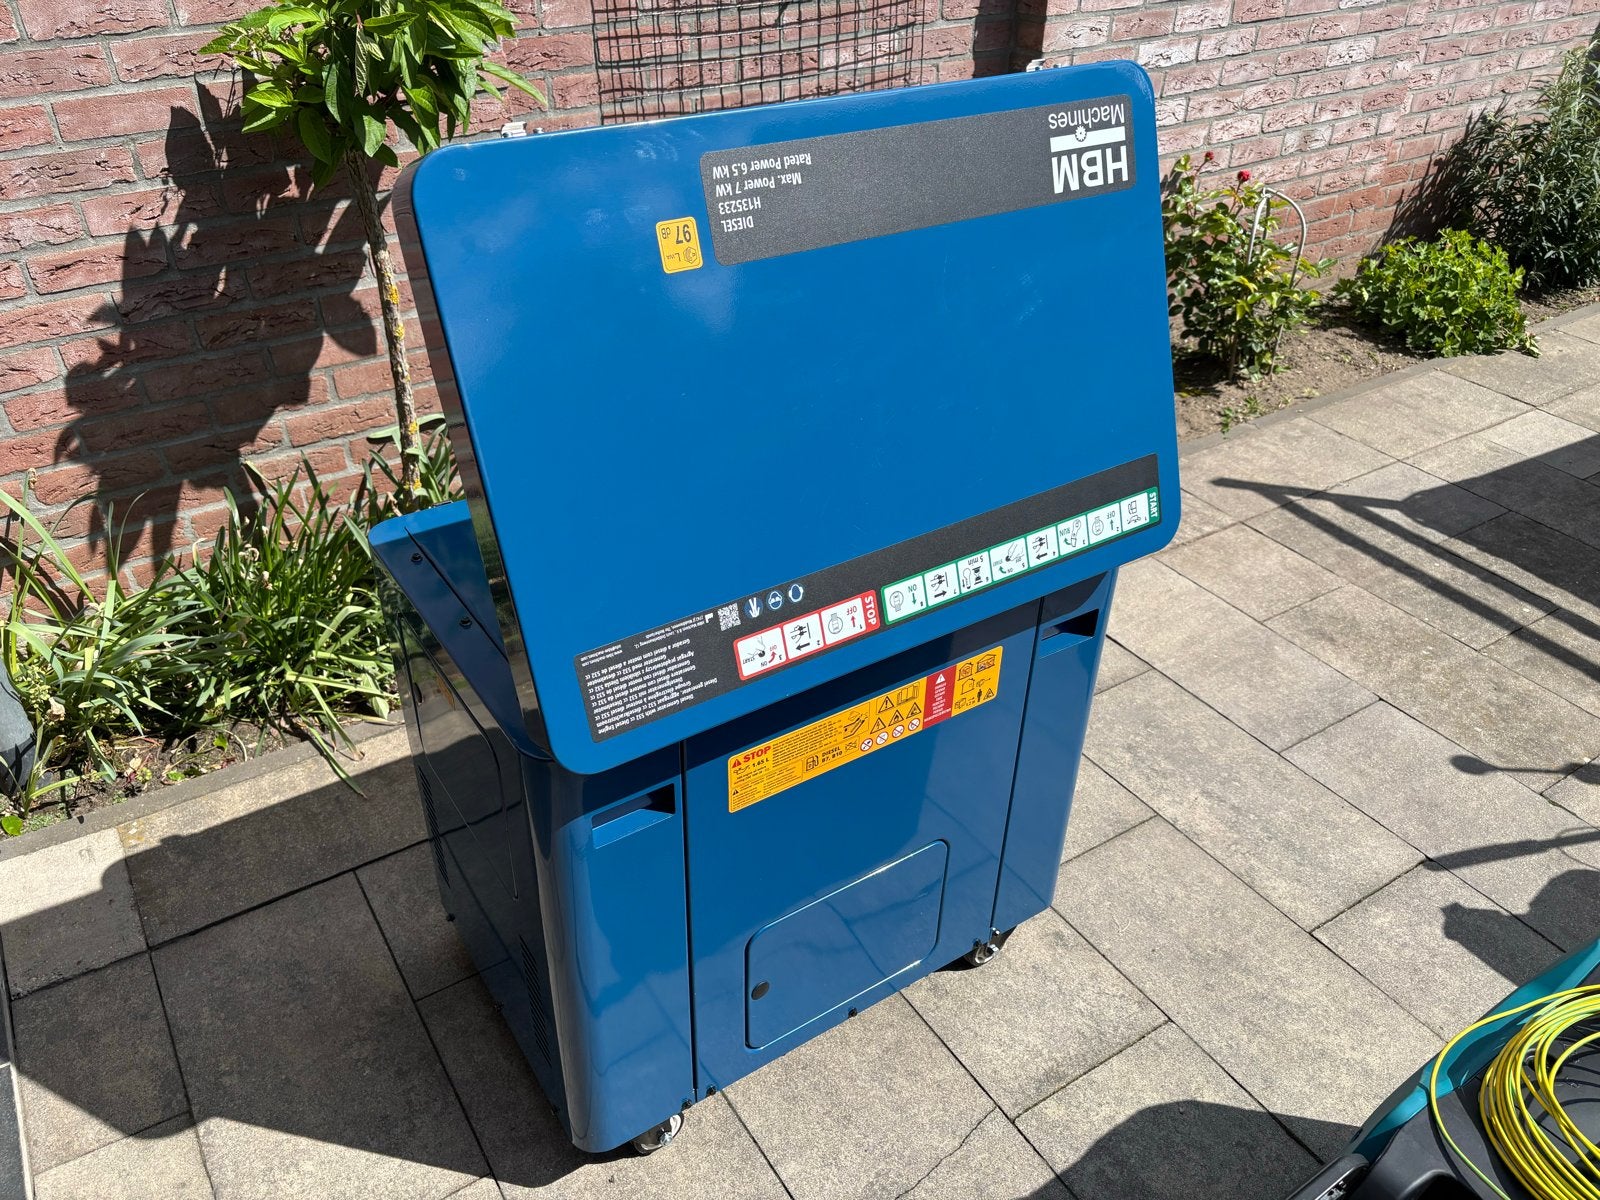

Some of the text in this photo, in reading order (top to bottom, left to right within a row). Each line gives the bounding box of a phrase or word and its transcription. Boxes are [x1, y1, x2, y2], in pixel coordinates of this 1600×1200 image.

[1048, 104, 1124, 129] Machines
[713, 153, 812, 180] Rated Power 6.5 kW
[1052, 146, 1128, 194] HBM
[716, 172, 802, 197] Max. Power 7 kW
[719, 197, 761, 215] H135233
[721, 216, 754, 232] DIESEL
[661, 224, 692, 244] 97 dB
[1149, 492, 1158, 517] START
[1106, 510, 1116, 520] OFF
[1059, 528, 1070, 537] RUN
[968, 557, 979, 566] min
[908, 584, 917, 593] ON
[846, 605, 857, 616] OFF
[864, 596, 876, 625] STOP
[644, 654, 666, 666] Generator
[704, 678, 717, 687] Diesel
[680, 694, 694, 703] Diesel
[657, 699, 680, 711] Generator
[598, 724, 615, 734] Engine
[615, 719, 630, 729] Diesel
[744, 746, 771, 762] STOP
